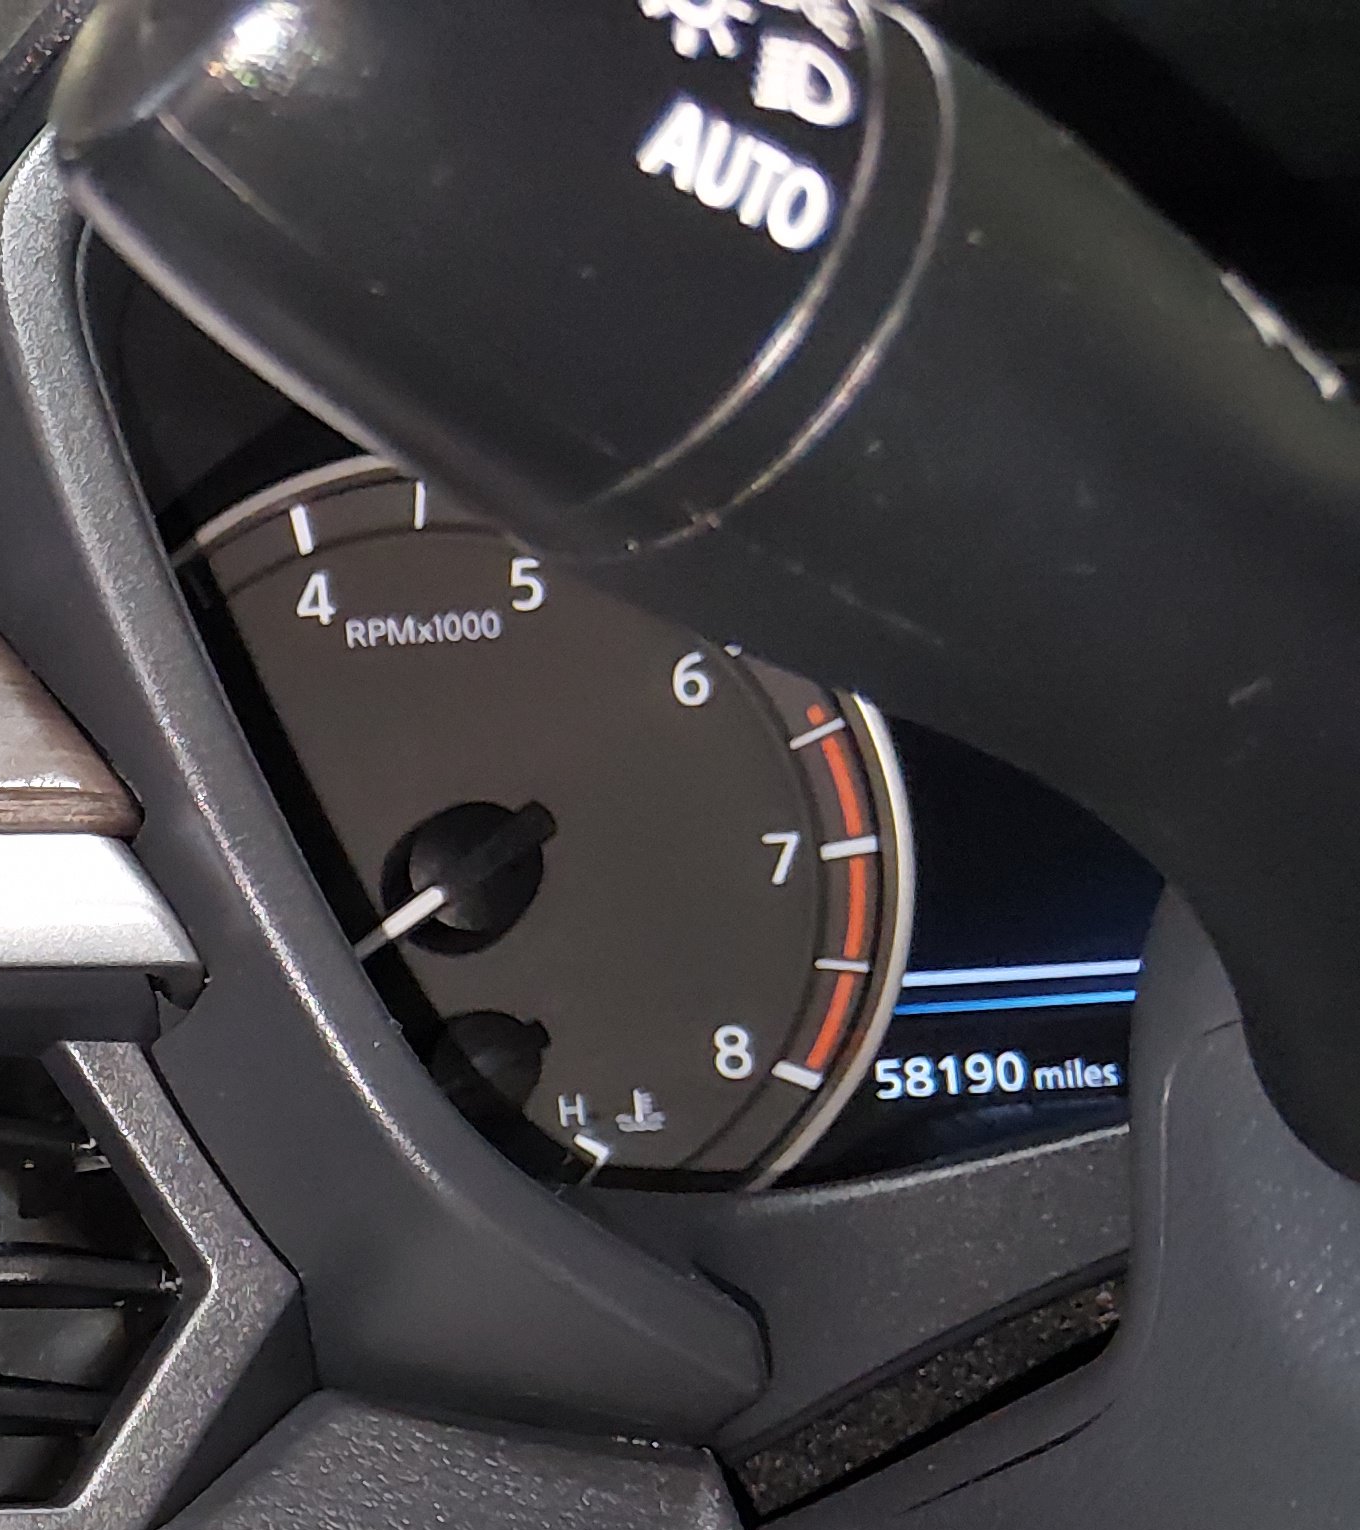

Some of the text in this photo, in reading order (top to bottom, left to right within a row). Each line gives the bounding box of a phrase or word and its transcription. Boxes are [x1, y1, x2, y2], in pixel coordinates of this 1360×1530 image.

[635, 98, 832, 251] AUTO
[295, 570, 337, 626] 4
[509, 556, 546, 612] 5
[344, 609, 502, 649] RPMx1000
[671, 650, 711, 706] 6
[760, 830, 801, 885] 7
[712, 1024, 755, 1080] 8
[874, 1050, 1120, 1100] 58190 miles
[557, 1092, 588, 1128] H
